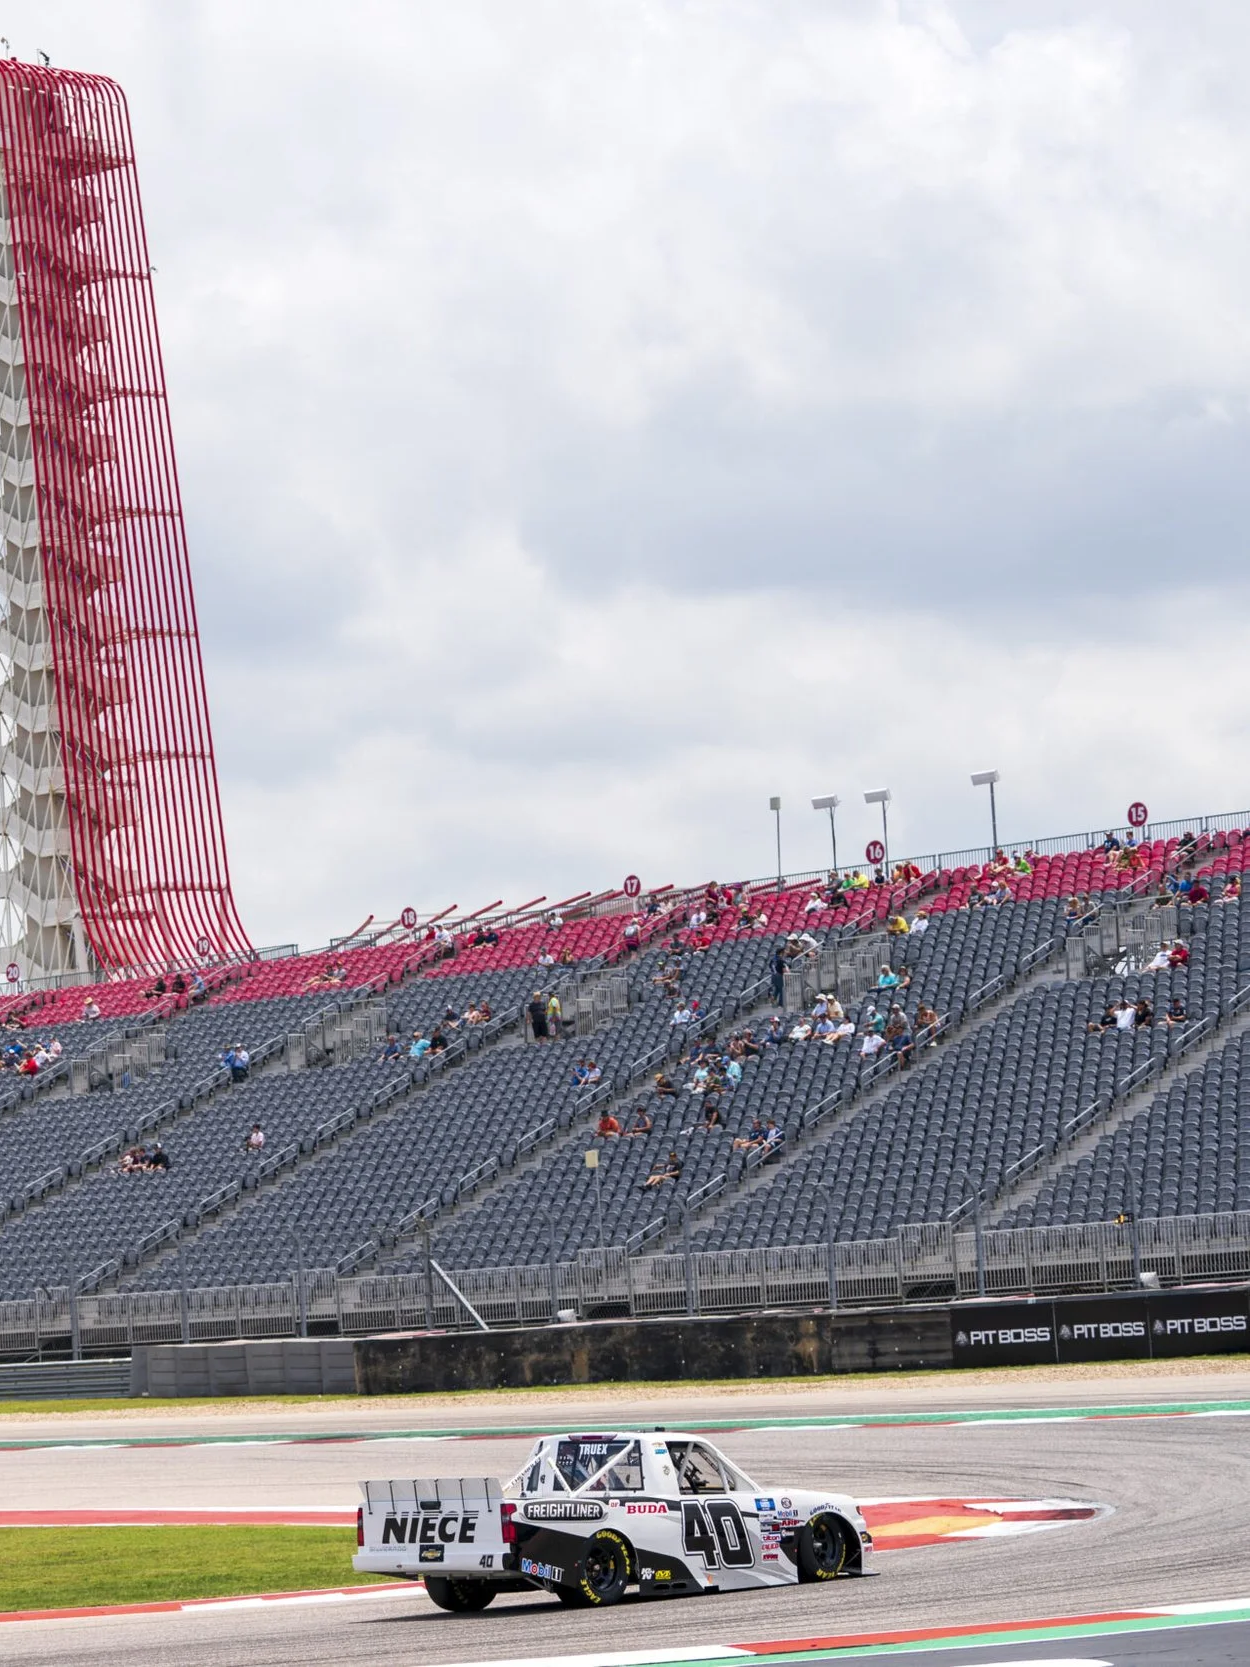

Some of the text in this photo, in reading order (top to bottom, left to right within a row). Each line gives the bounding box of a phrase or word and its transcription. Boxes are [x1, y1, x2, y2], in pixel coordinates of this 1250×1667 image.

[1131, 807, 1144, 822] 15
[869, 845, 882, 860] 16
[626, 878, 639, 894] 17
[403, 910, 416, 926] 18
[198, 939, 208, 953] 19
[7, 966, 17, 979] 20
[1073, 1321, 1145, 1339] PIT BOSS
[1166, 1316, 1247, 1335] PIT BOSS
[970, 1327, 1051, 1345] PIT BOSS
[579, 1443, 608, 1456] TRUEX
[527, 1503, 601, 1518] FREIGHTLINER
[627, 1505, 667, 1514] BUDA
[382, 1511, 479, 1544] NIECE
[680, 1499, 755, 1570] 40
[479, 1554, 494, 1569] 40
[521, 1557, 551, 1579] Mobil
[580, 1578, 601, 1604] EAGLE
